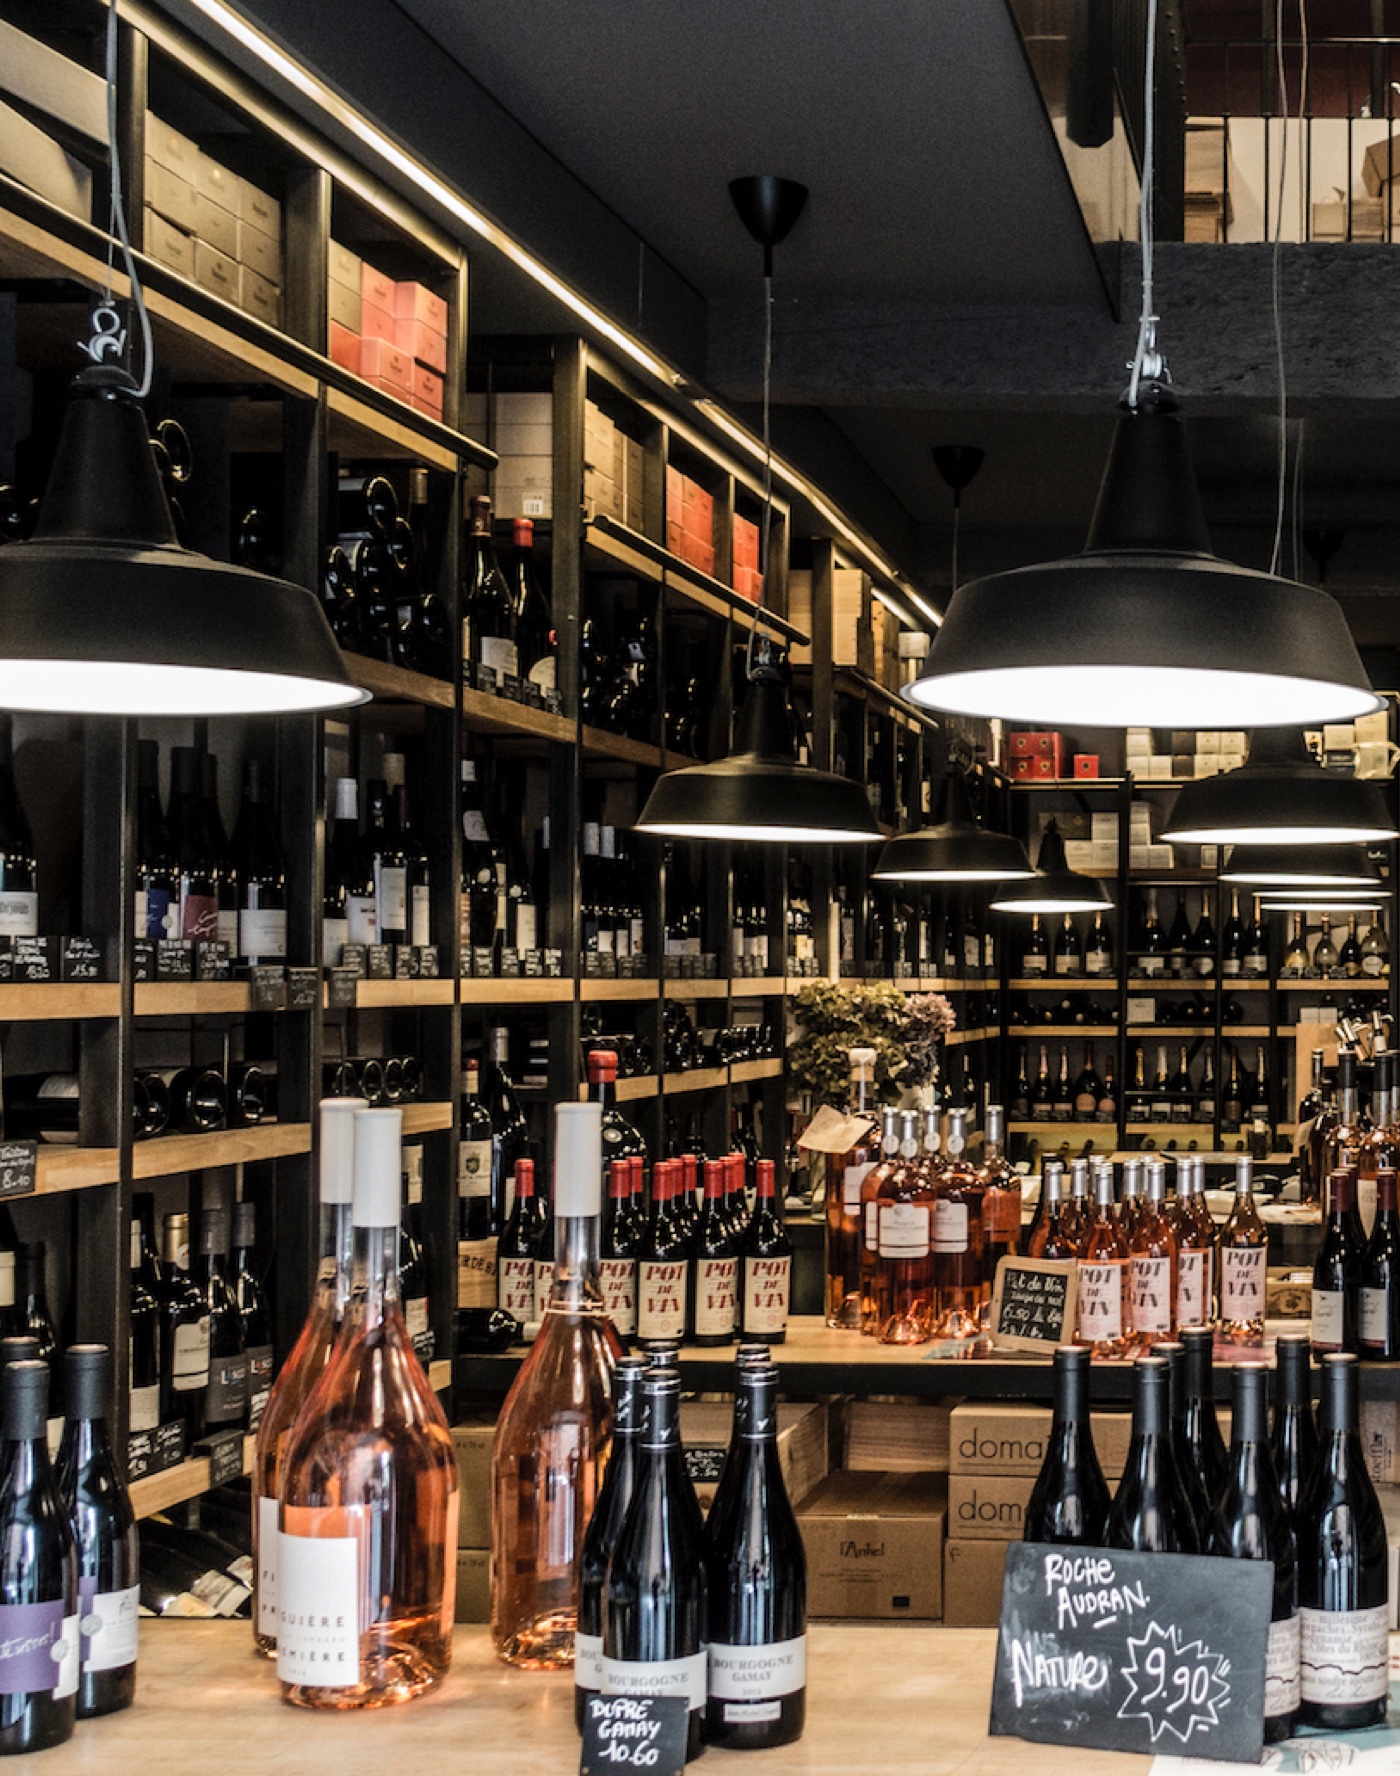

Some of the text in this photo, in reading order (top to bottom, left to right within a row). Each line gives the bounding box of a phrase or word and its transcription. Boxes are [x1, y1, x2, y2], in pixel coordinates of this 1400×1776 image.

[713, 1654, 794, 1670] BOURGOGNE
[608, 1672, 690, 1685] BOURGOGNE
[732, 1670, 773, 1682] GAMAY
[1141, 1646, 1209, 1714] 9.90
[598, 1718, 662, 1739] GAMAY
[598, 1739, 660, 1766] 10.60
